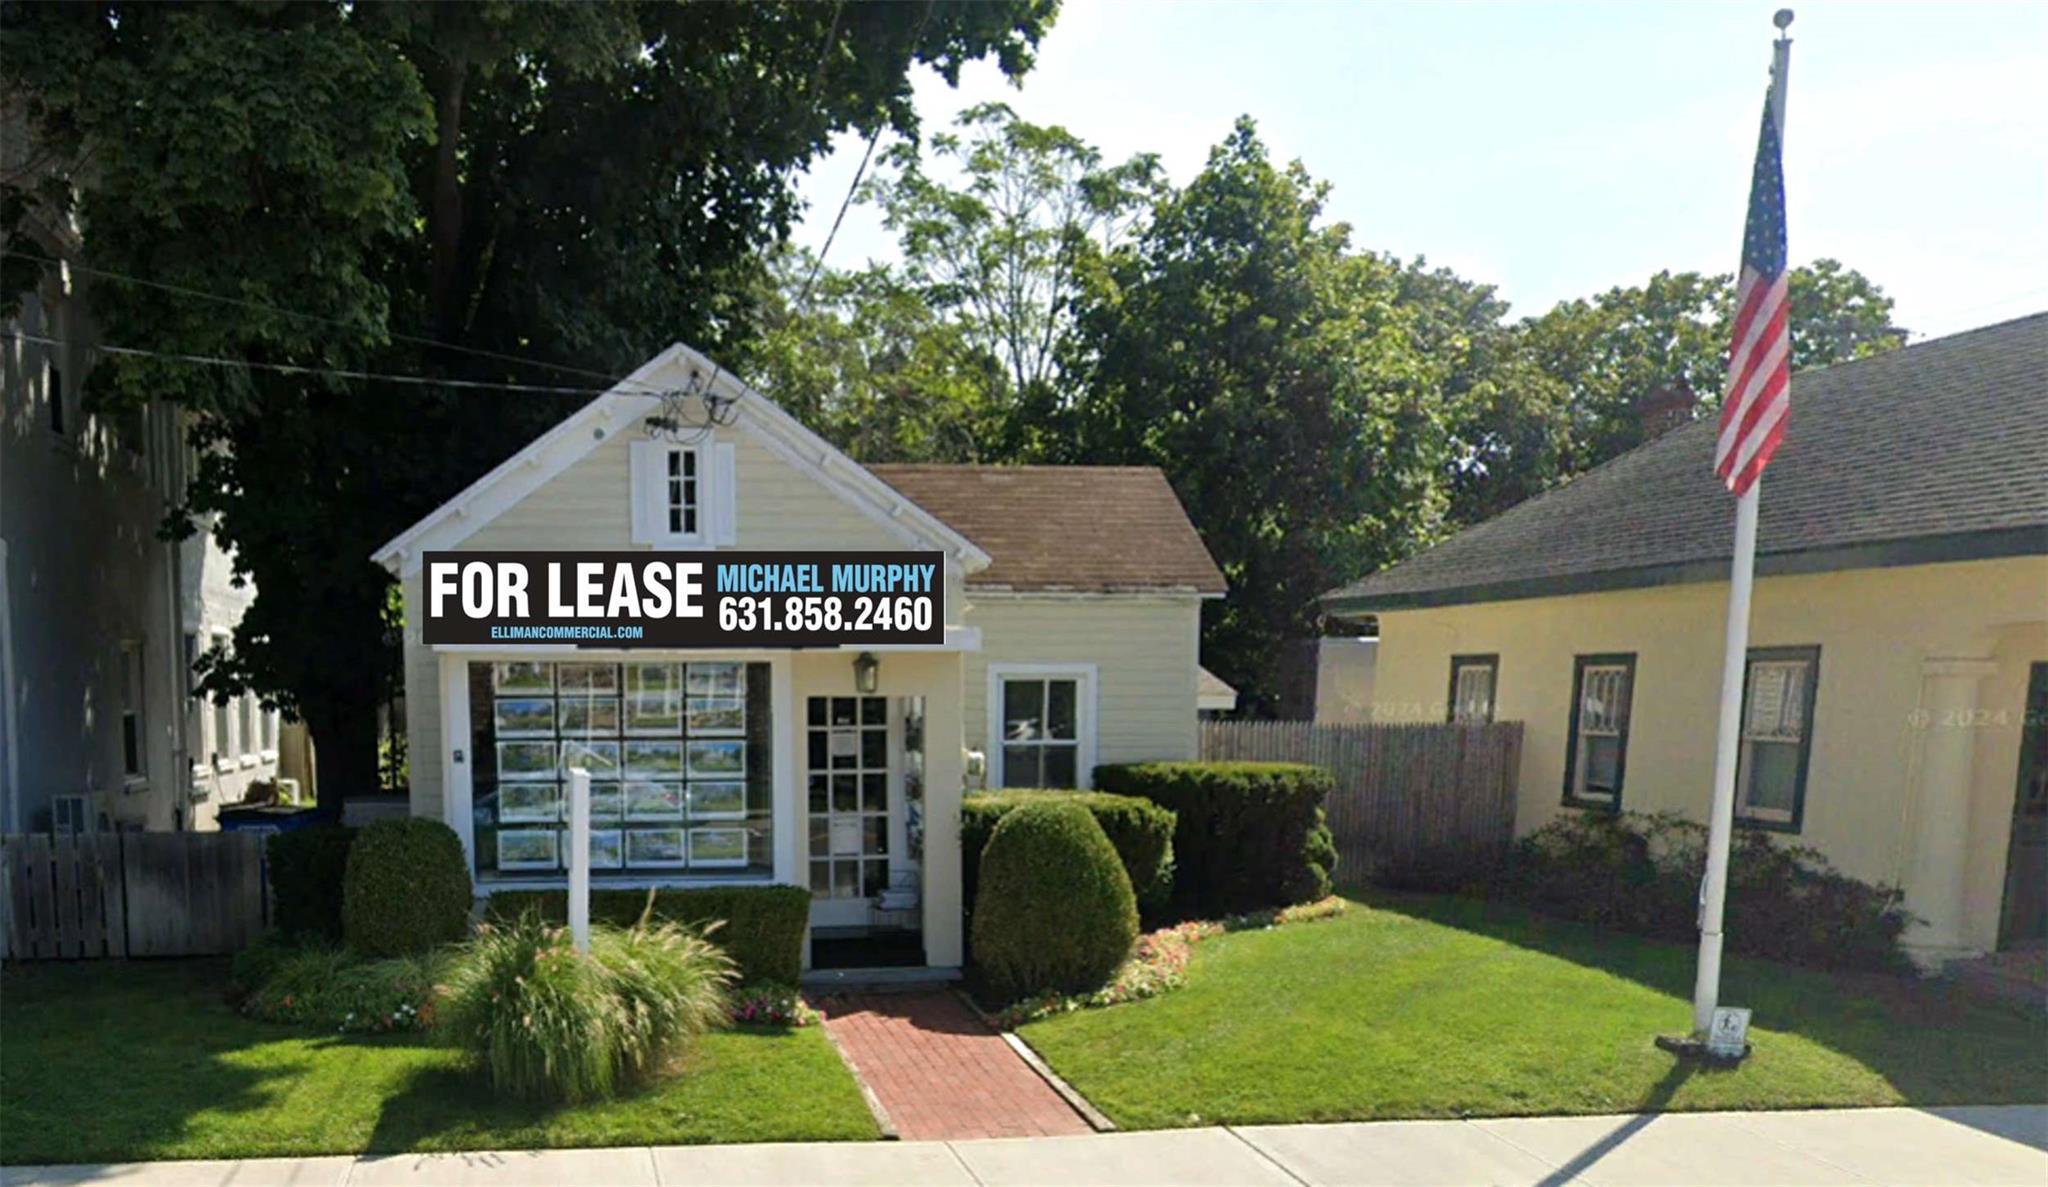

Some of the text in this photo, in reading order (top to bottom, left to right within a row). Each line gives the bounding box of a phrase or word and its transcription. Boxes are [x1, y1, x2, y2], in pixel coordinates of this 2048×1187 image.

[430, 561, 704, 618] FOR LEASE
[717, 564, 936, 593] MICHAEL MURPHY
[718, 596, 933, 632] 631.858.2460
[491, 626, 643, 639] ELLIMANCOMMERCIAL.COM
